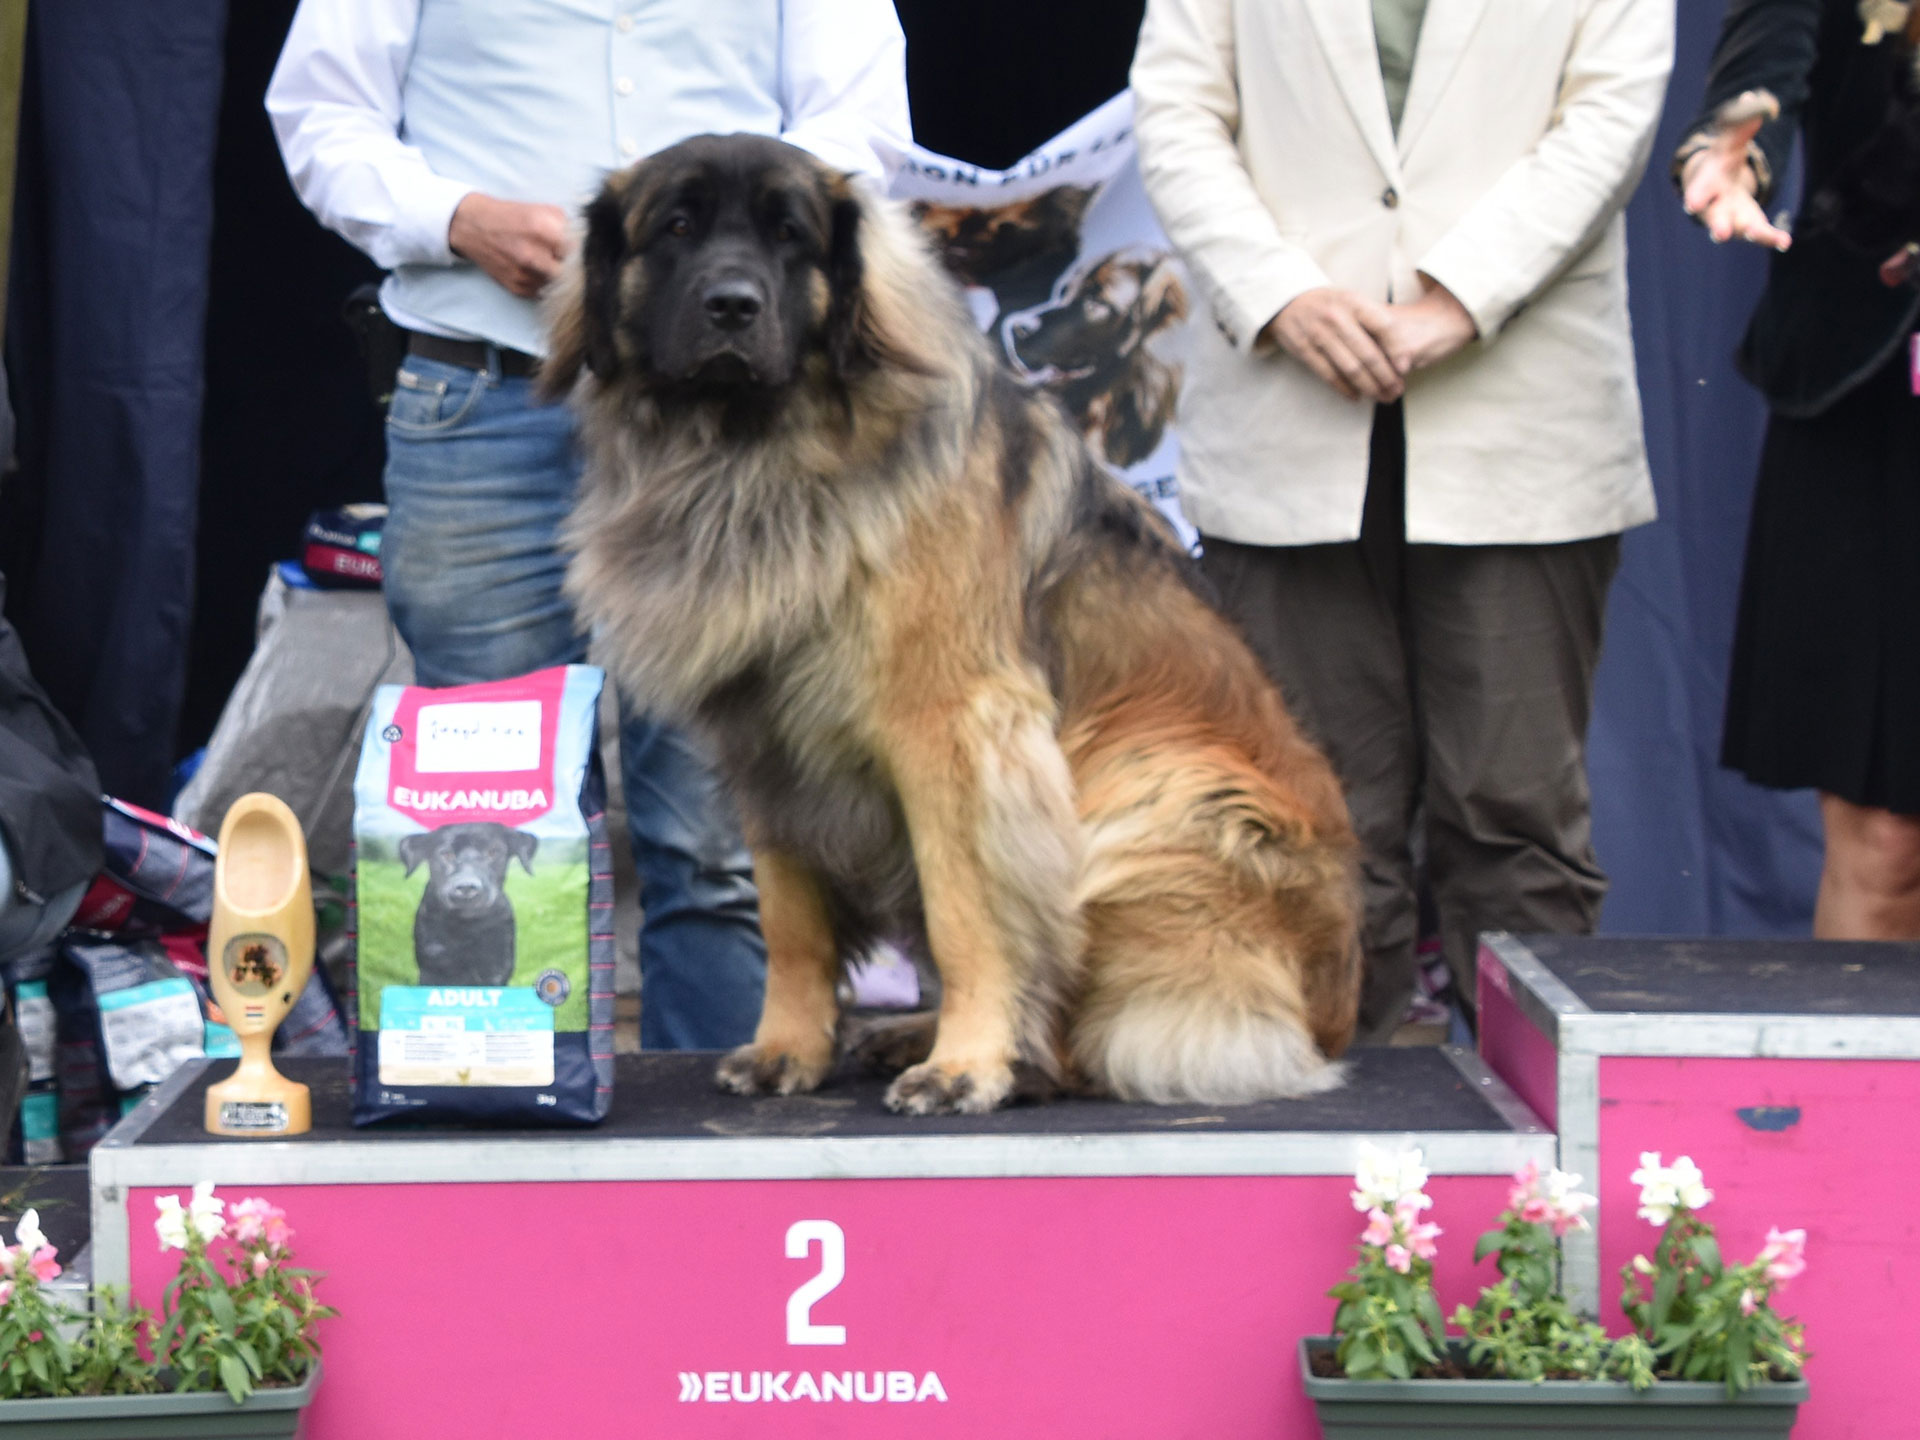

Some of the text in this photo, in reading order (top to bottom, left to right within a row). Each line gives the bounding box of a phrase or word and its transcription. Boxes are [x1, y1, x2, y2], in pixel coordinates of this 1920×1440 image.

[393, 785, 548, 811] EUKANUBA
[426, 988, 503, 1008] ADULT
[785, 1219, 846, 1345] 2
[704, 1371, 949, 1402] EUKANUBA
